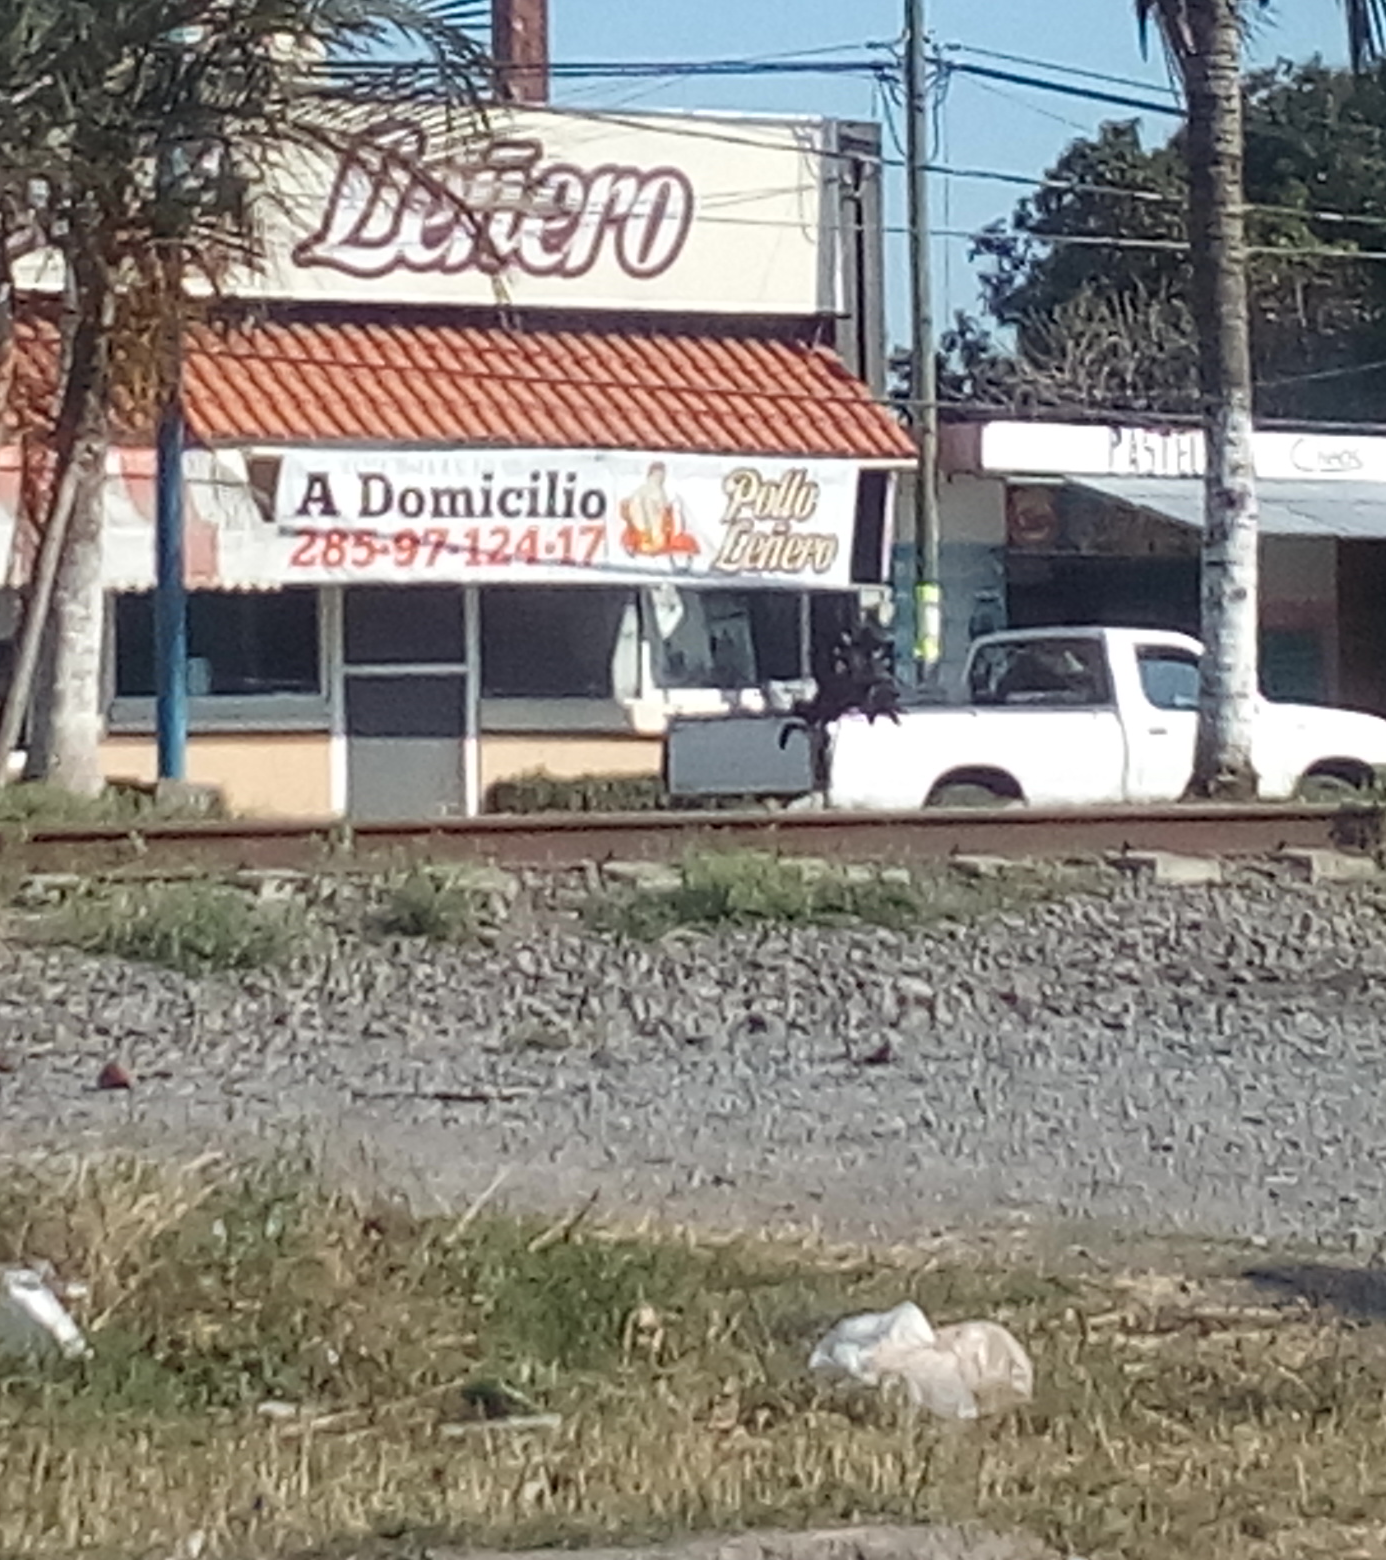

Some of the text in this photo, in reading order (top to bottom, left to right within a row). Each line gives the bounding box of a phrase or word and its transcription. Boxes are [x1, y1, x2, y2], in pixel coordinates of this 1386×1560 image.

[292, 120, 694, 279] Leñero
[296, 471, 607, 519] A Domicilio
[721, 467, 821, 524] Pollo
[711, 517, 839, 576] Leñero
